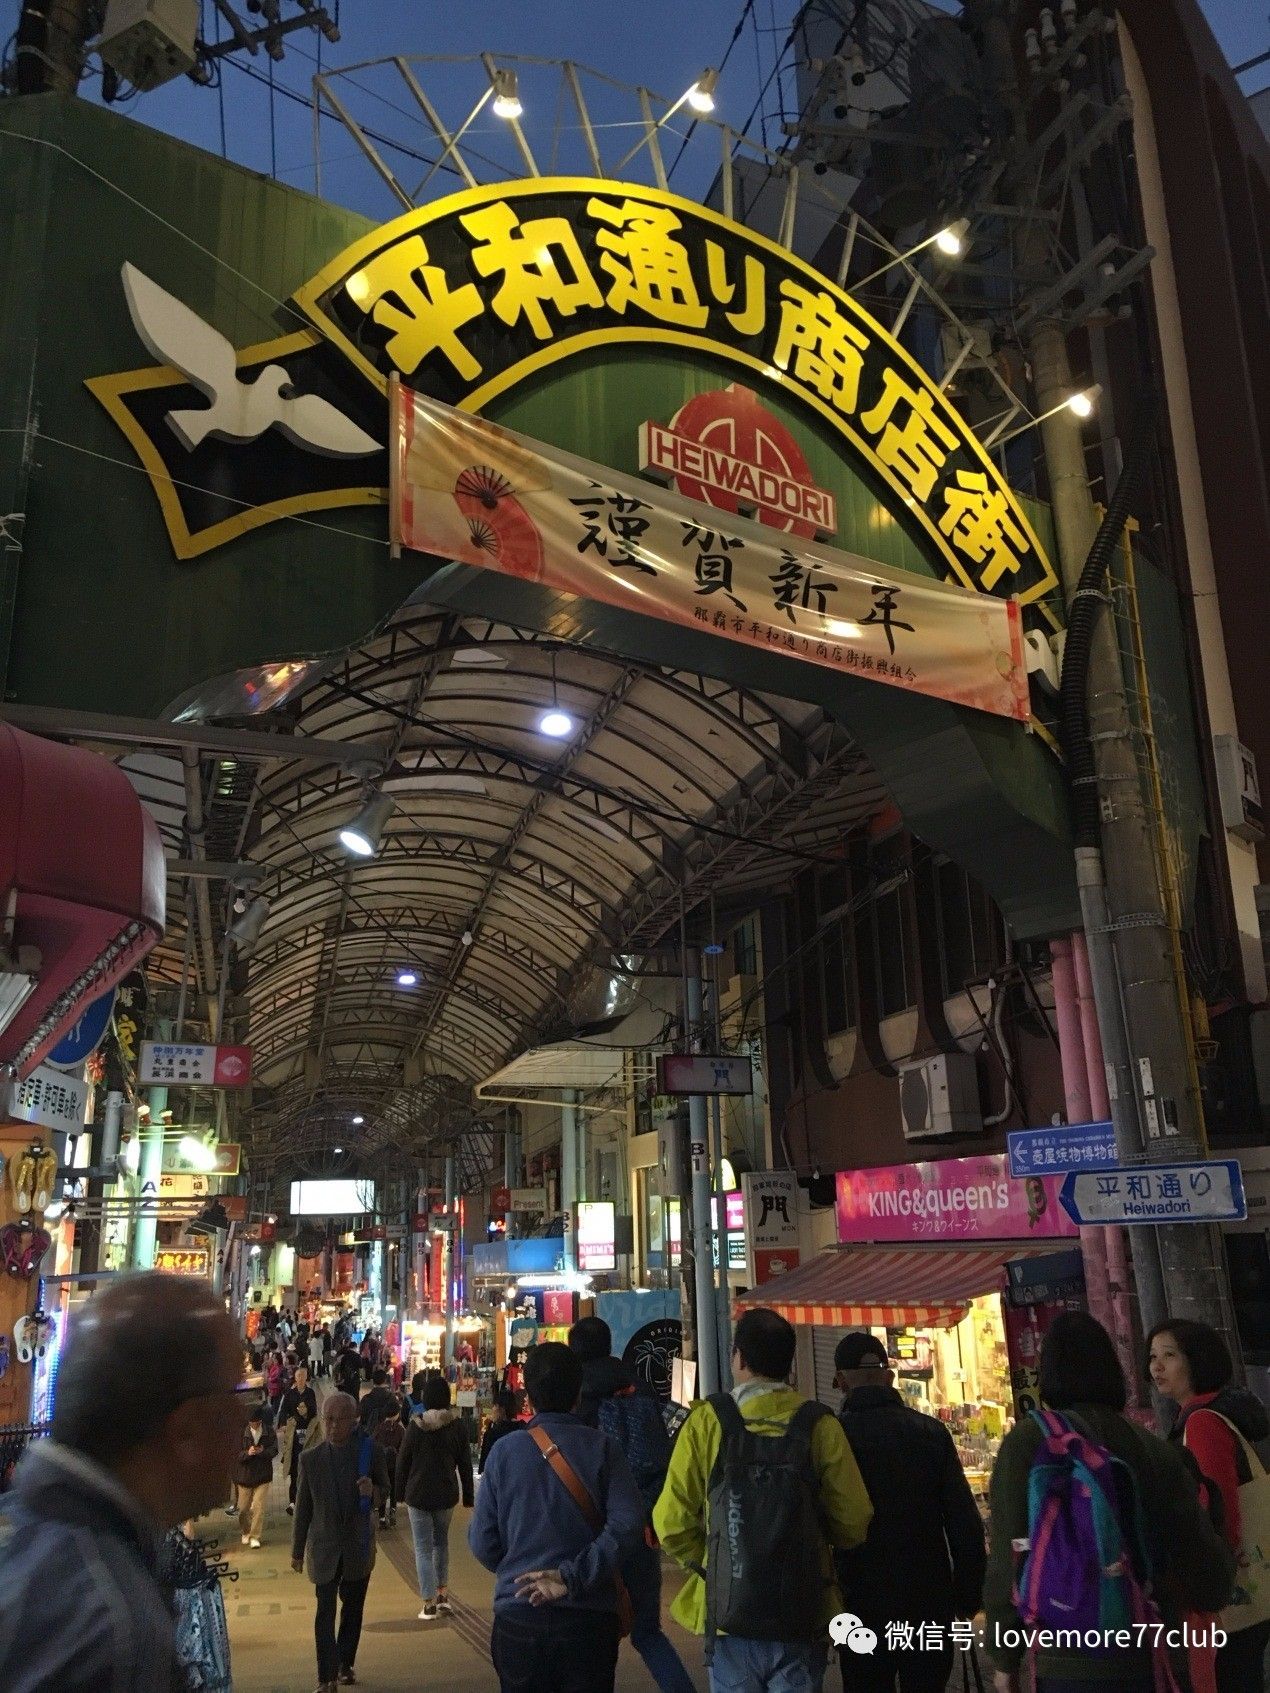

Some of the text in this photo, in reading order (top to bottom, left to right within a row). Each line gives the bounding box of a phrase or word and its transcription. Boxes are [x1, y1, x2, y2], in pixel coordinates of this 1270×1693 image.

[347, 196, 1031, 588] 平和通り商店街
[657, 436, 832, 525] HEIWADORI
[567, 481, 915, 654] 謹賀新年
[868, 1181, 1009, 1218] KING&queen's
[1096, 1172, 1211, 1200] 平和通り
[758, 1195, 791, 1228] 門
[1124, 1199, 1191, 1216] Heiwadori
